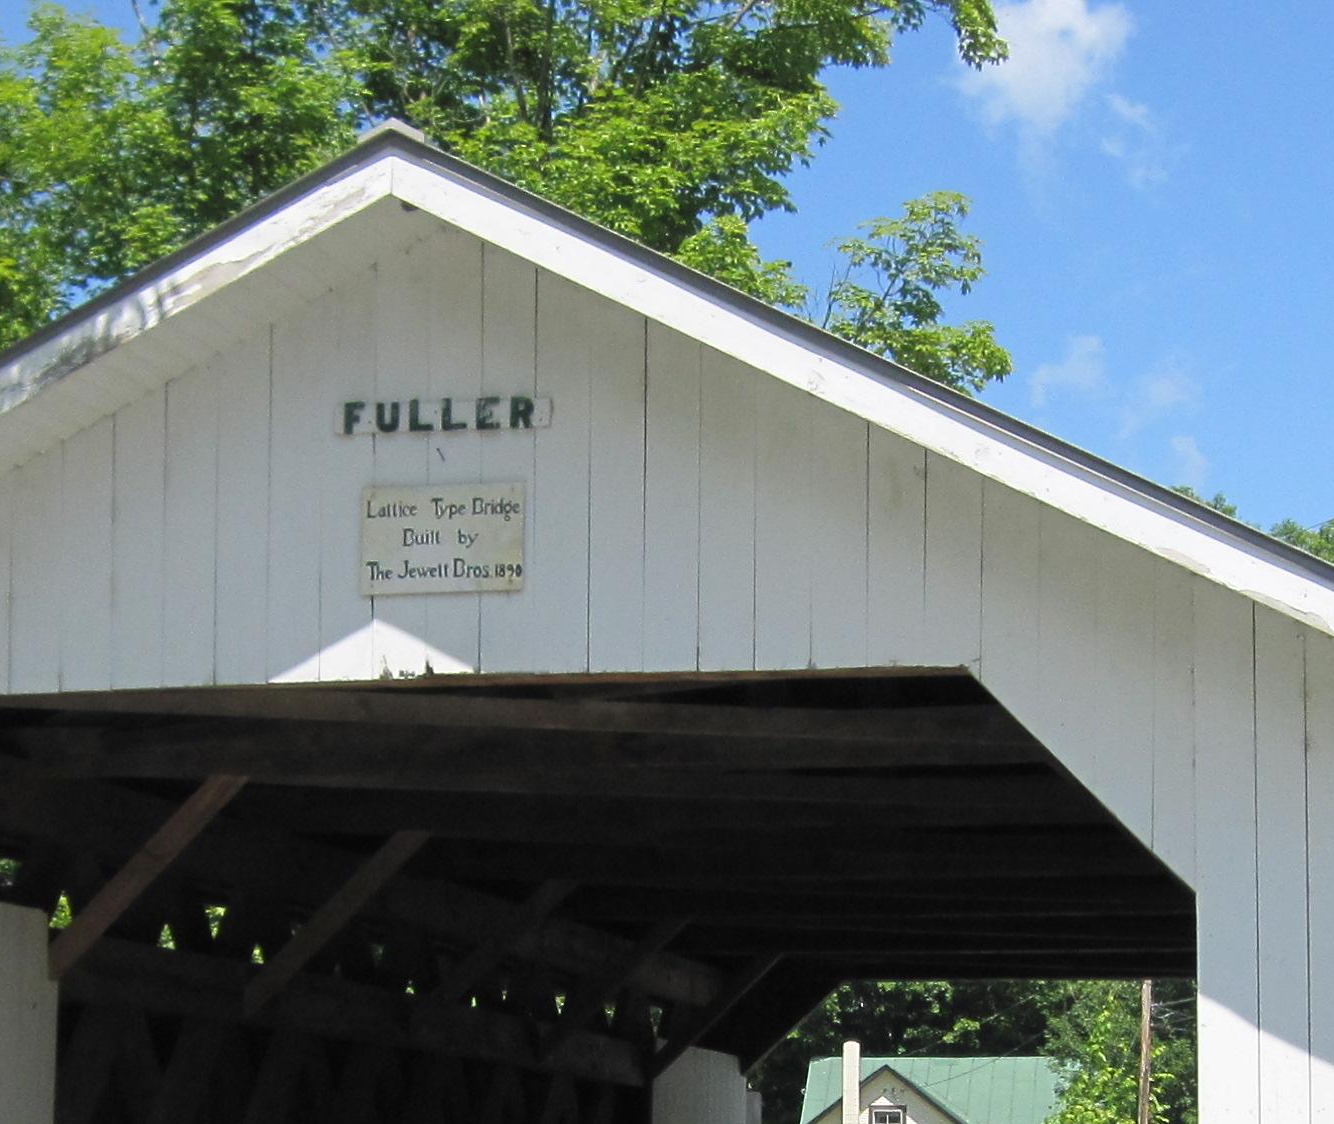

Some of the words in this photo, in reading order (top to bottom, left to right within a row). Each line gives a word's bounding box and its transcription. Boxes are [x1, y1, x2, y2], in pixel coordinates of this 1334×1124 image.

[343, 397, 535, 435] FULLER
[367, 500, 417, 519] Lattice
[431, 498, 466, 519] Type
[471, 498, 520, 521] Bridge
[403, 528, 440, 547] Built
[458, 529, 479, 548] by
[366, 561, 393, 580] The
[495, 563, 522, 578] 1890
